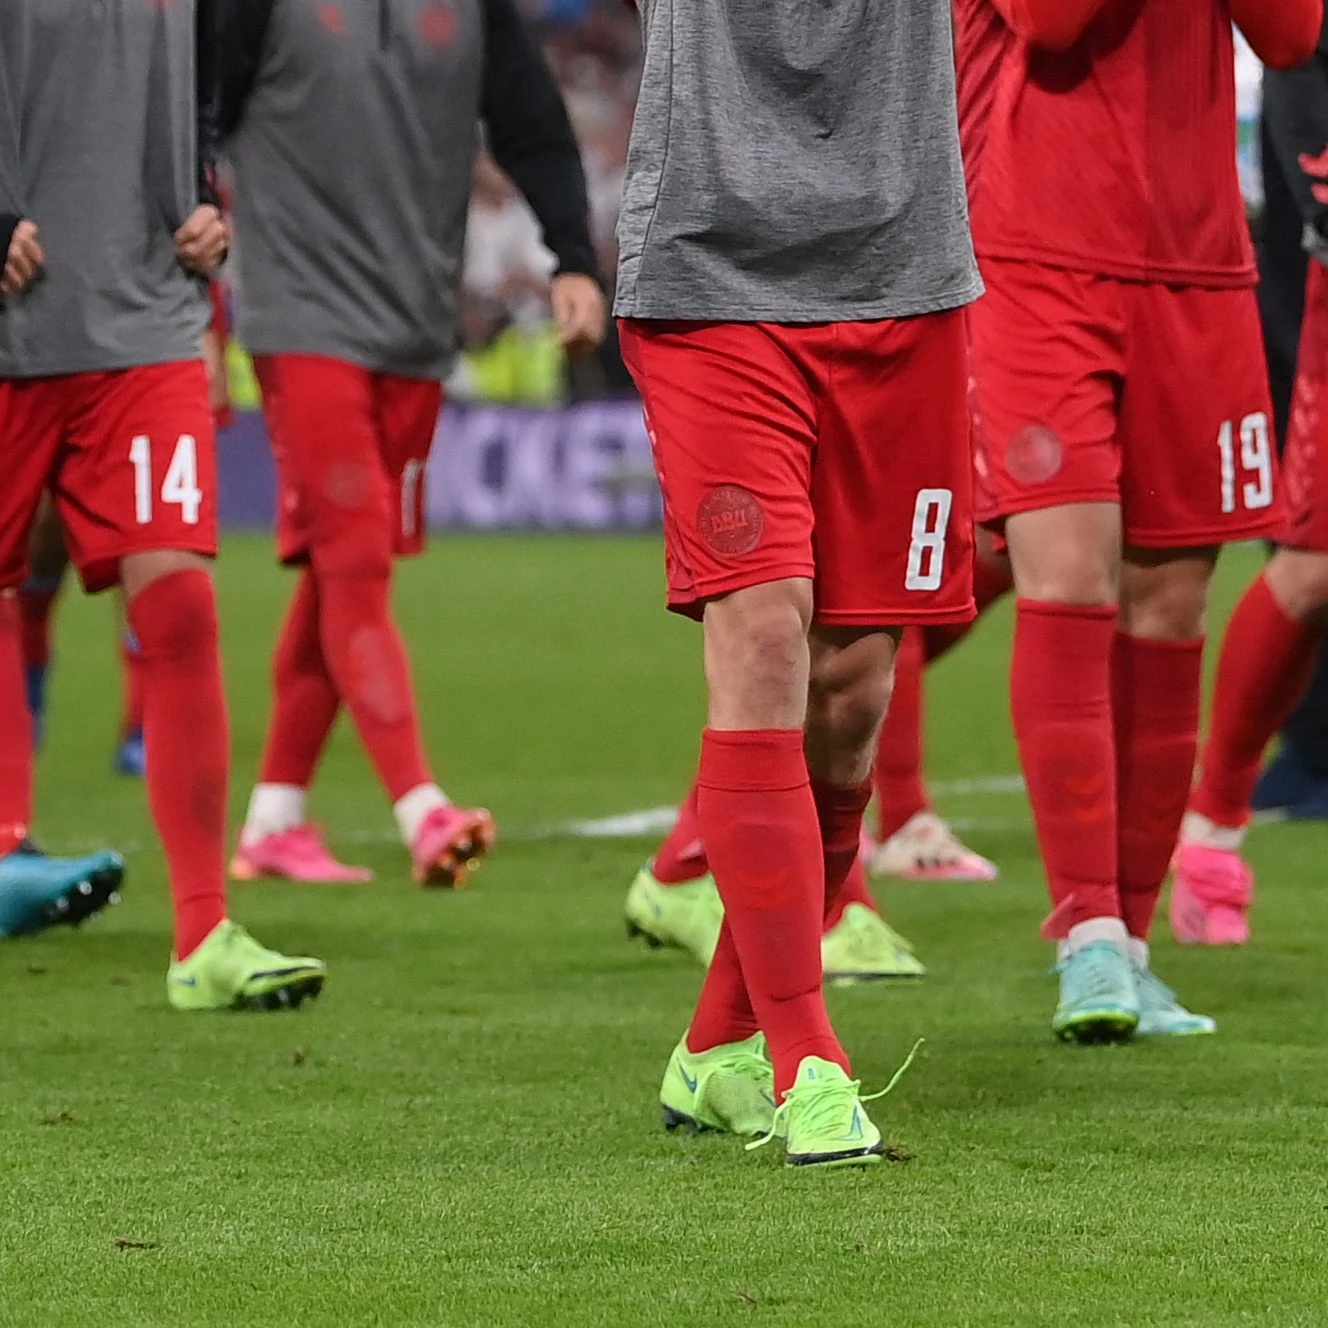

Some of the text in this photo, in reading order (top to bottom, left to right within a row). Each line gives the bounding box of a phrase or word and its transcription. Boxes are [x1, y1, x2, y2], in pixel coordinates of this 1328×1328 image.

[128, 434, 203, 525] 14
[1216, 411, 1273, 513] 19
[905, 488, 953, 591] 8
